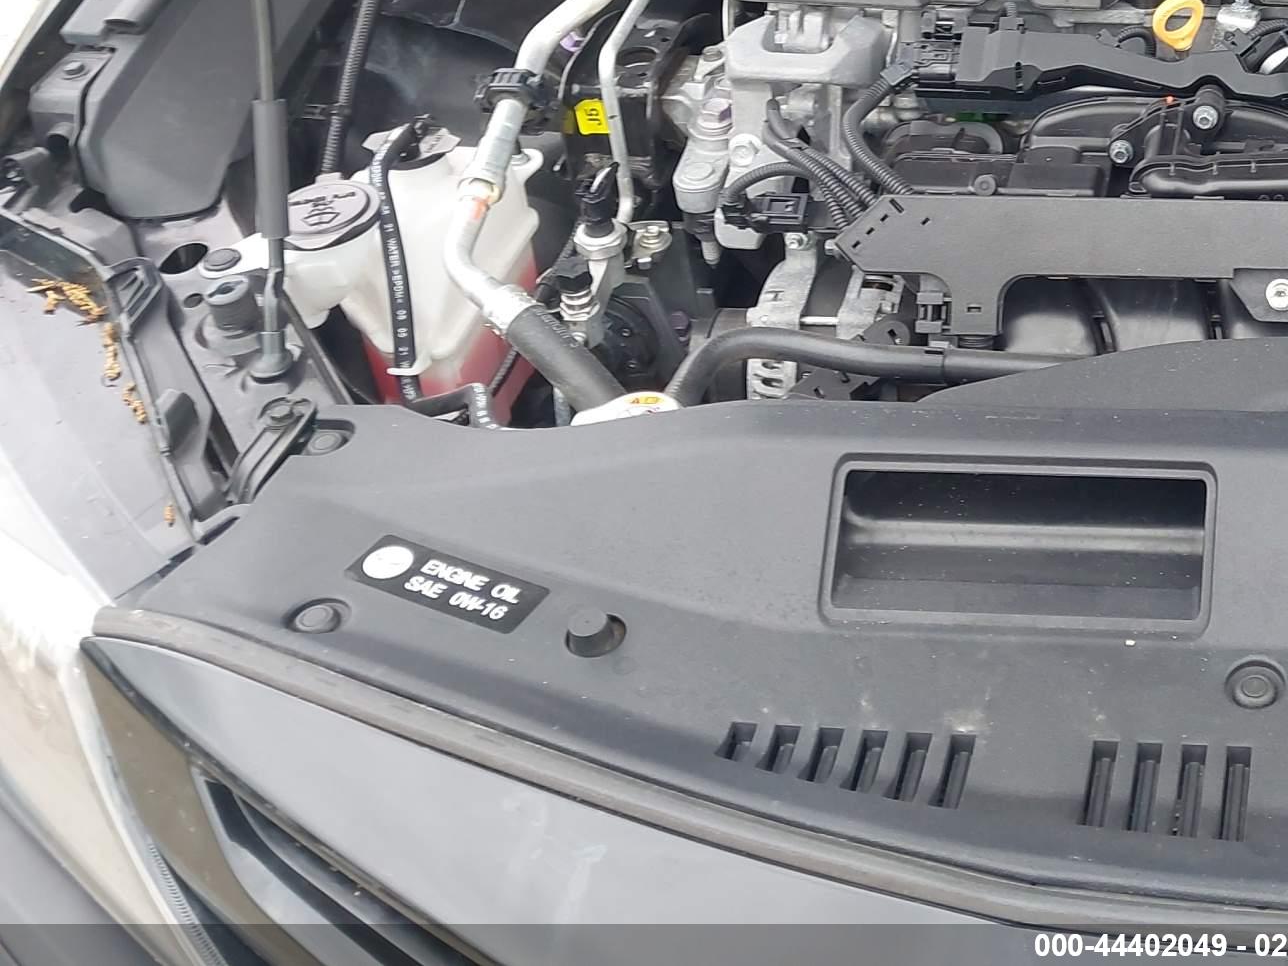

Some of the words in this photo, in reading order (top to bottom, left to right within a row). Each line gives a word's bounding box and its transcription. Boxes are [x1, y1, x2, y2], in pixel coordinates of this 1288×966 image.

[404, 576, 448, 600] SAE
[449, 591, 510, 621] 0W-16
[420, 559, 490, 591] ENGINE
[490, 582, 520, 604] OIL
